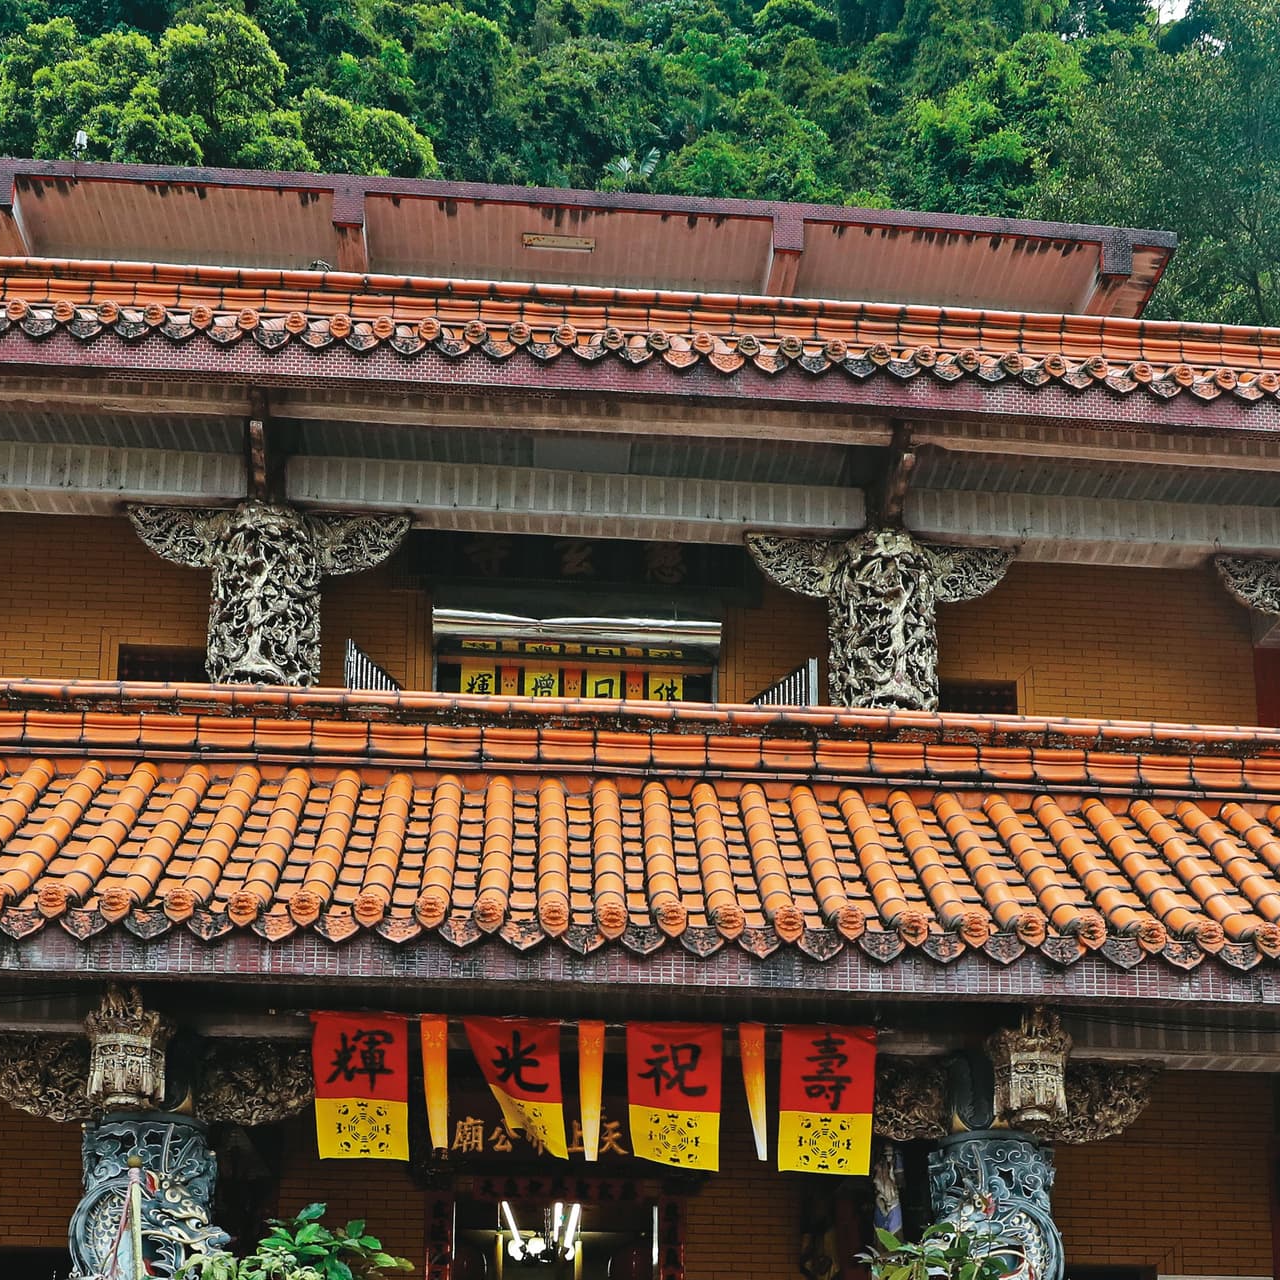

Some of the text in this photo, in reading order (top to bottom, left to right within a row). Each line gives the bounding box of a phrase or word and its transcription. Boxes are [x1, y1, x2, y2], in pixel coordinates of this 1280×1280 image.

[326, 1029, 396, 1093] 輝
[491, 1029, 550, 1093] 光
[638, 1041, 709, 1098] 祝
